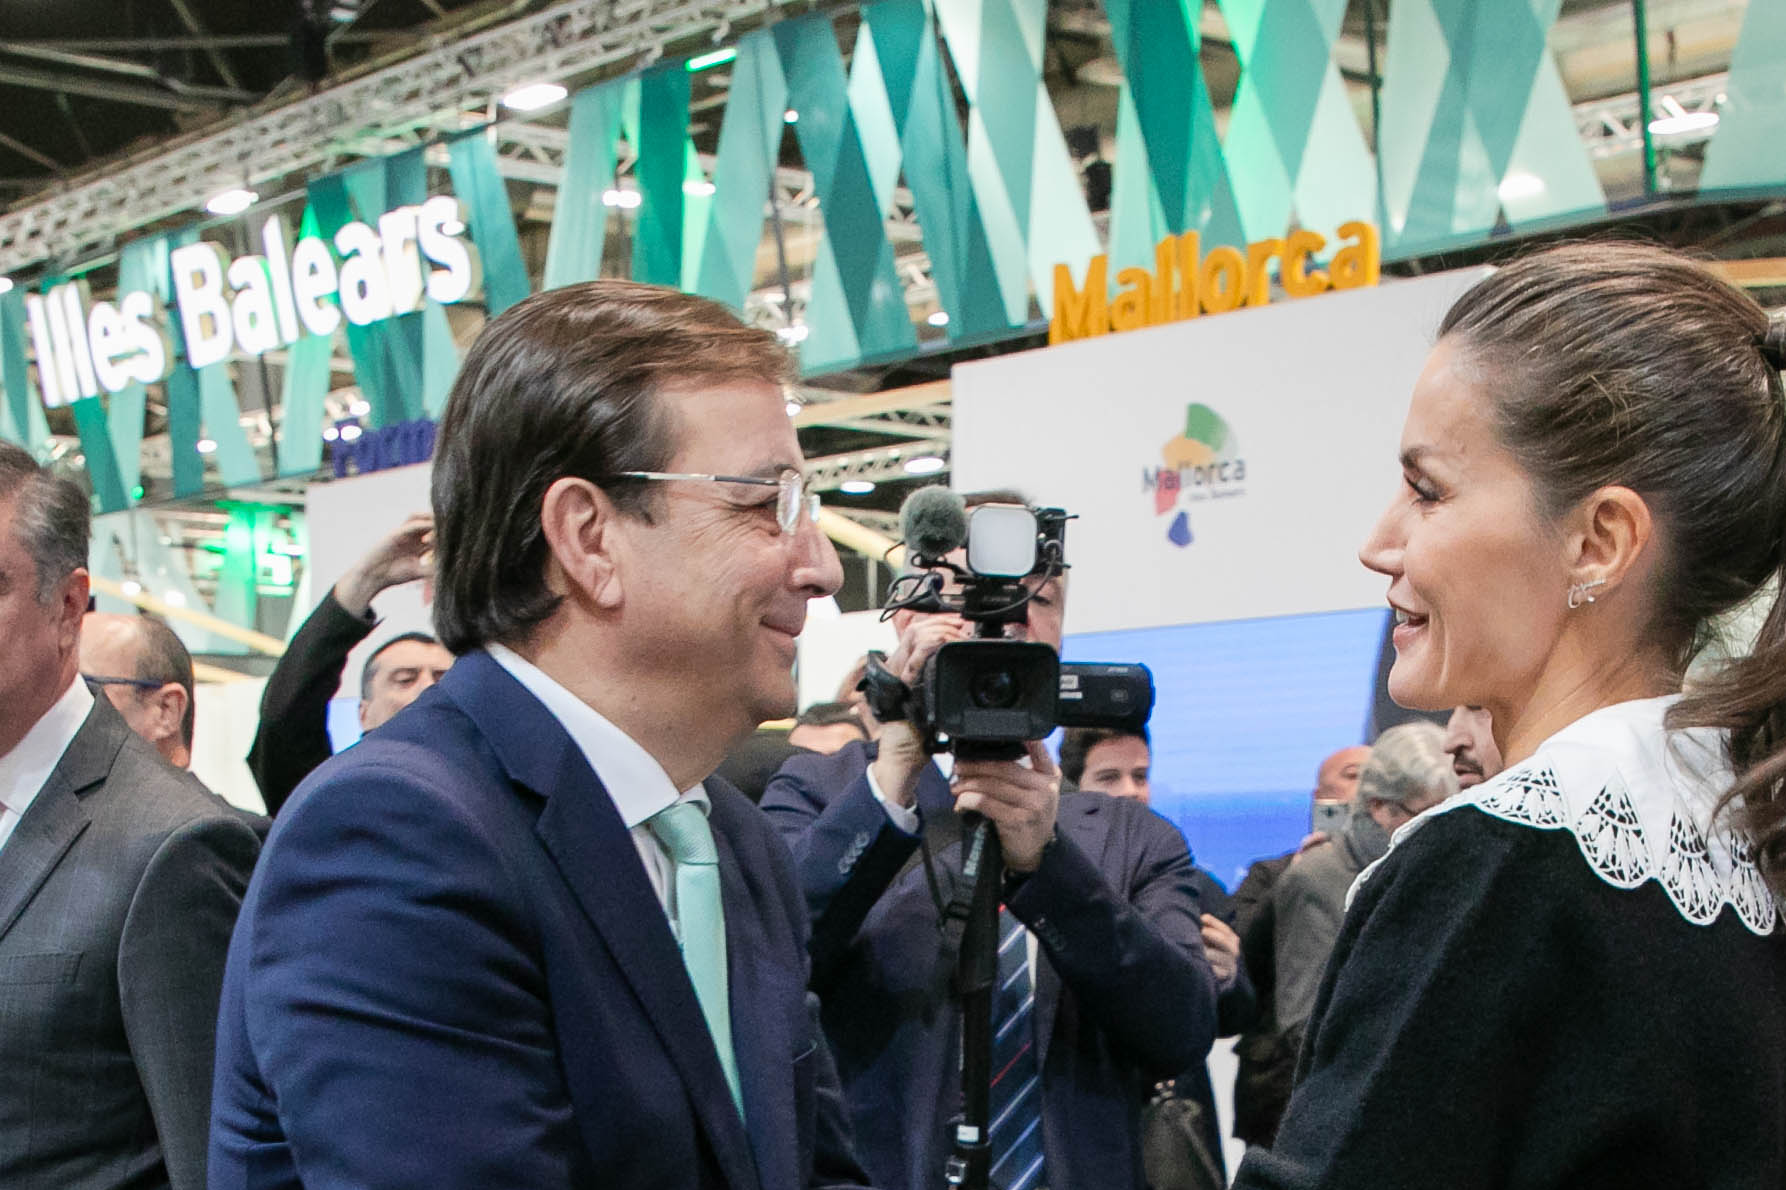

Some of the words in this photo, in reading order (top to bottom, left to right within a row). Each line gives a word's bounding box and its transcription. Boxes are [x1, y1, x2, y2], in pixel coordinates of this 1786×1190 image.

[28, 280, 167, 408] Illes
[171, 196, 477, 369] Balears
[1048, 221, 1380, 347] Mallorca
[1142, 458, 1246, 494] Mallorca
